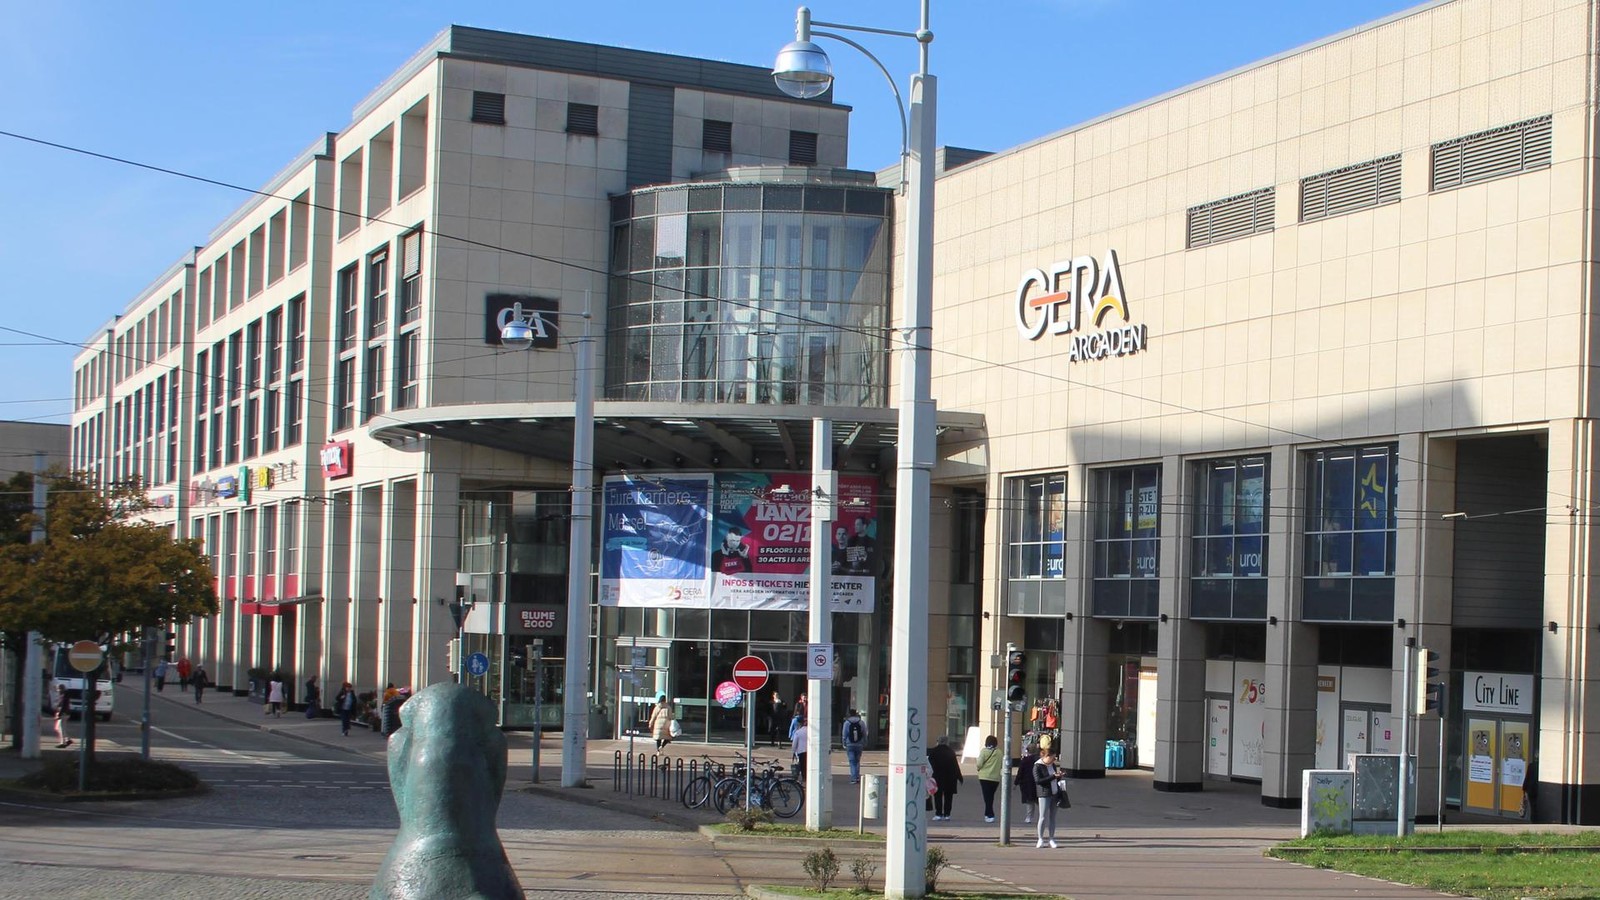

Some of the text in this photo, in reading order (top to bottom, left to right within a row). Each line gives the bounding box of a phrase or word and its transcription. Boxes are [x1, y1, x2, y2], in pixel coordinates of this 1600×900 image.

[1015, 248, 1128, 342] GERA
[496, 306, 549, 339] CA
[1068, 323, 1147, 362] ARCADEN
[722, 579, 747, 588] INFOS
[747, 579, 755, 588] &
[756, 580, 793, 589] TICKETS
[682, 587, 703, 596] GERA
[521, 610, 556, 620] BLUME
[523, 619, 553, 628] 2000
